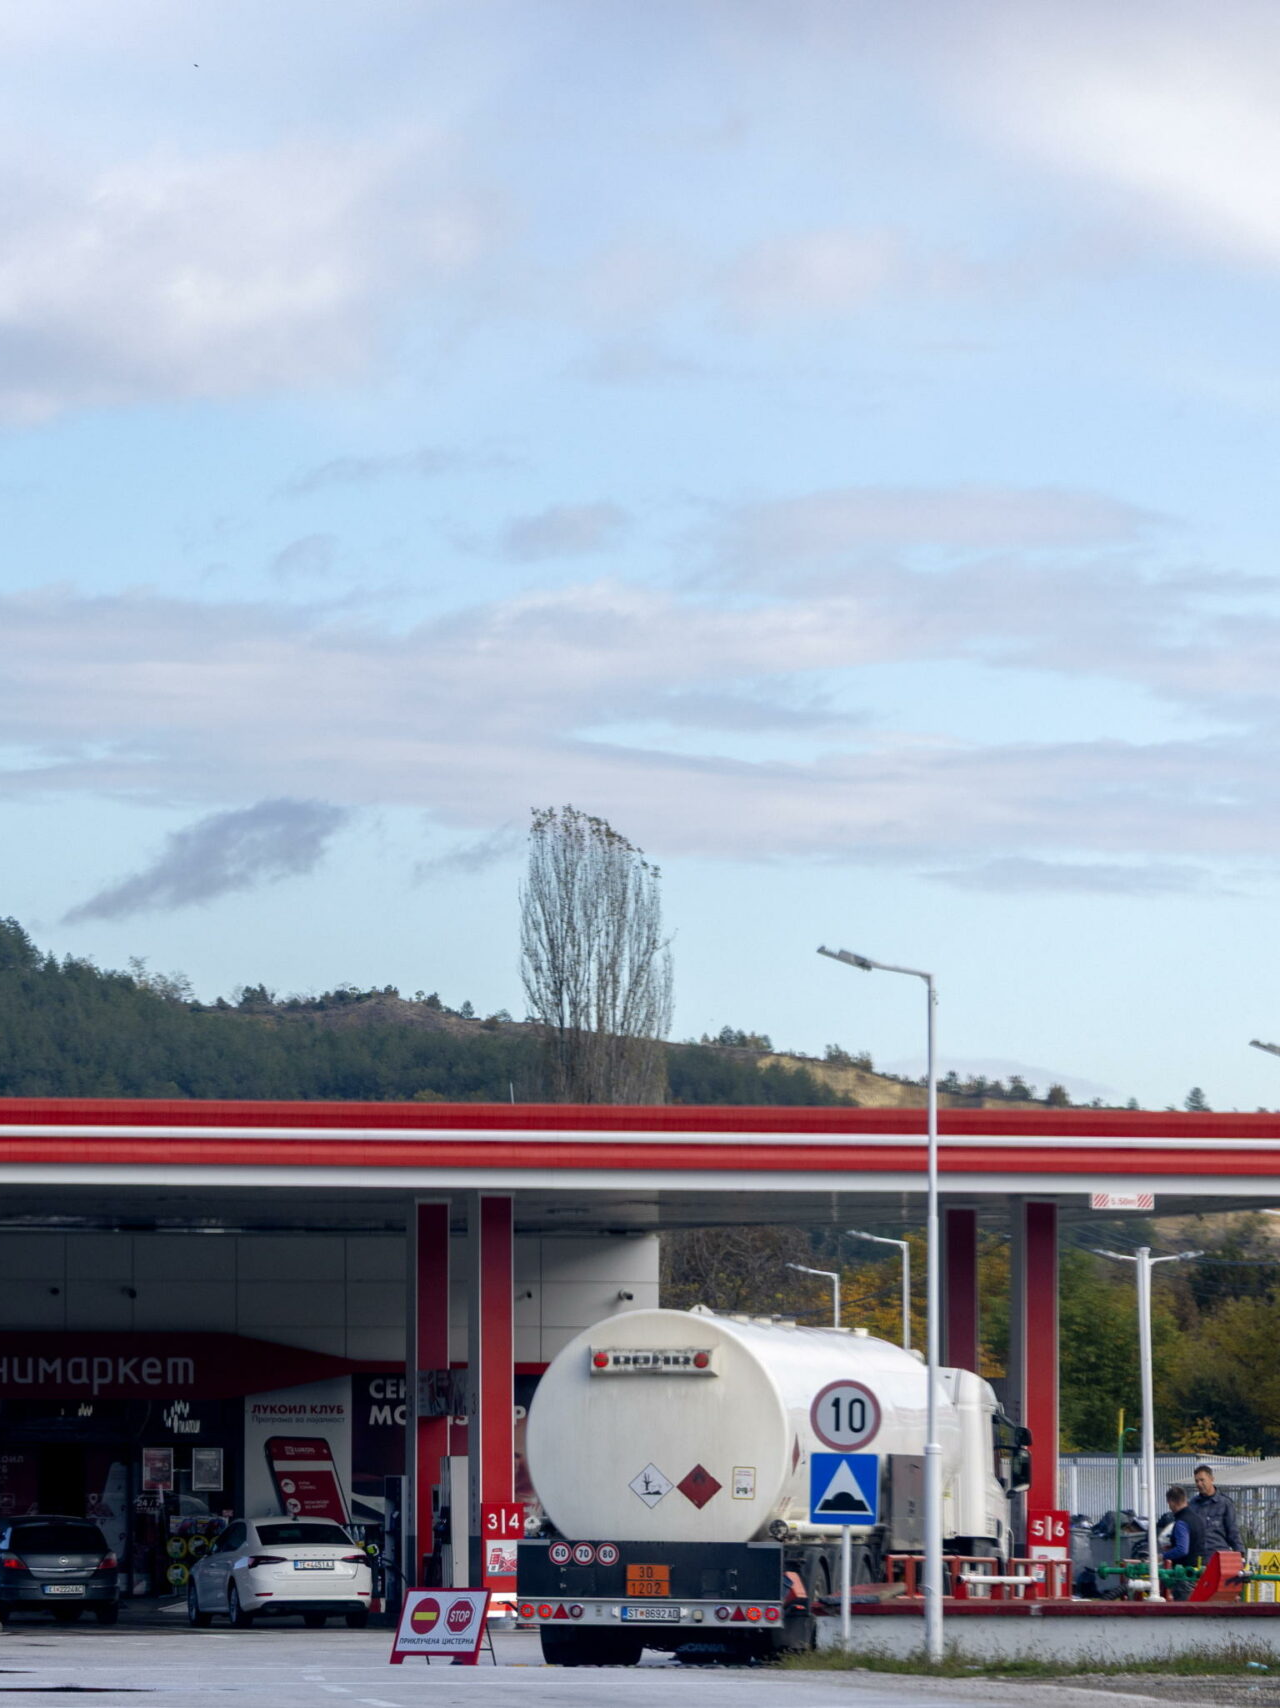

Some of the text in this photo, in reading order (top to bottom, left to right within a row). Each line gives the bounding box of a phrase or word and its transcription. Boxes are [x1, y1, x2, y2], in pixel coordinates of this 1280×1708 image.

[251, 1404, 344, 1415] ЛУКОИЛ КЛУБ
[832, 1397, 866, 1433] 10
[554, 1549, 567, 1559] 60
[578, 1549, 590, 1559] 70
[602, 1549, 614, 1559] 80
[639, 1566, 654, 1578] 30
[631, 1583, 662, 1595] 1202
[450, 1610, 470, 1623] STOP
[399, 1638, 475, 1646] ПРИКЛУЧЕНА ЦИСТЕРНА
